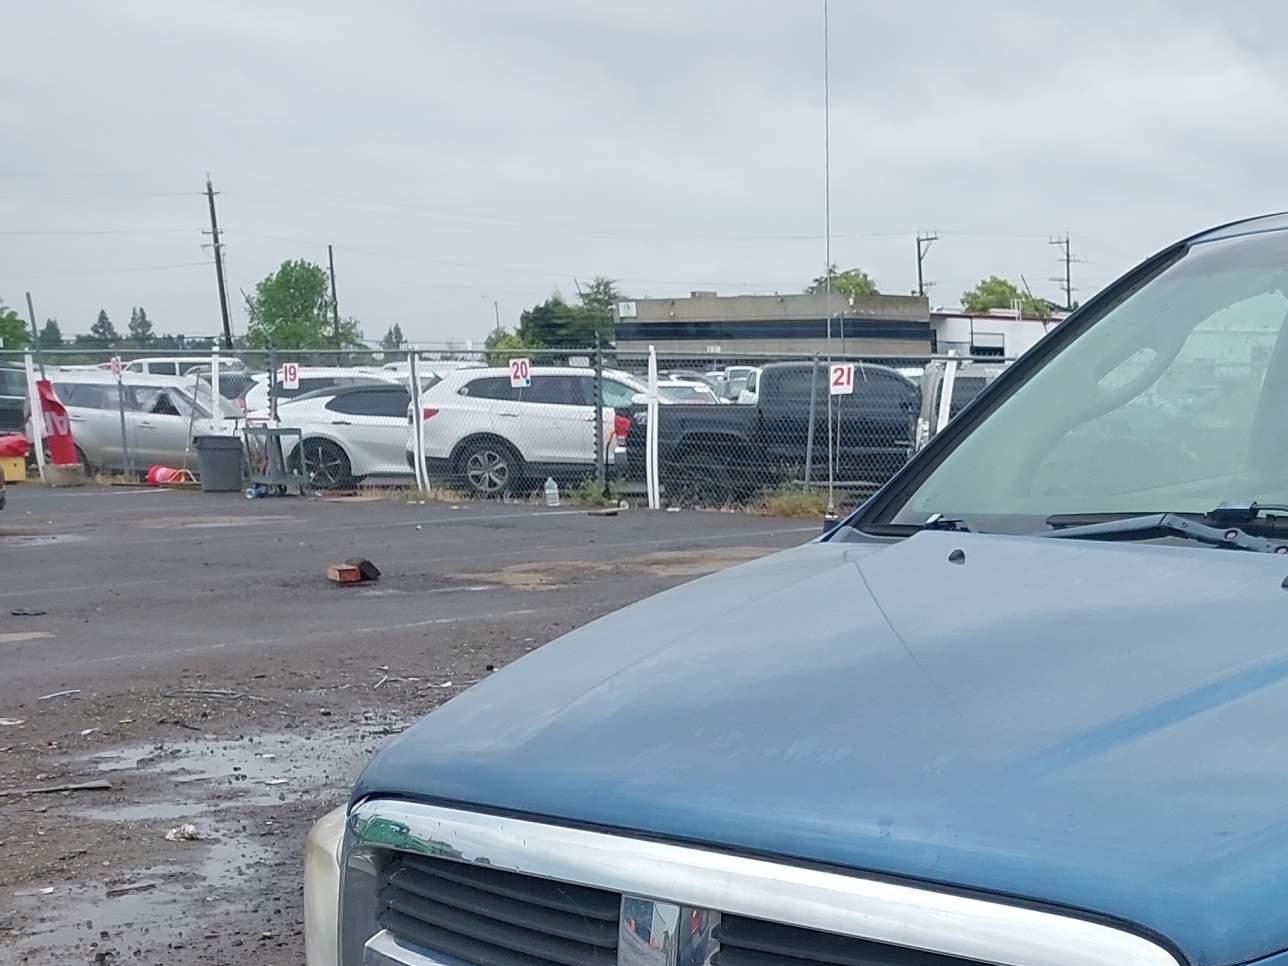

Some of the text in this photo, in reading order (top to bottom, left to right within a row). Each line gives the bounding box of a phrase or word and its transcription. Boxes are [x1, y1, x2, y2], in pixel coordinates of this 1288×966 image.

[284, 364, 297, 382] 19
[511, 360, 529, 380] 20
[832, 366, 852, 386] 21
